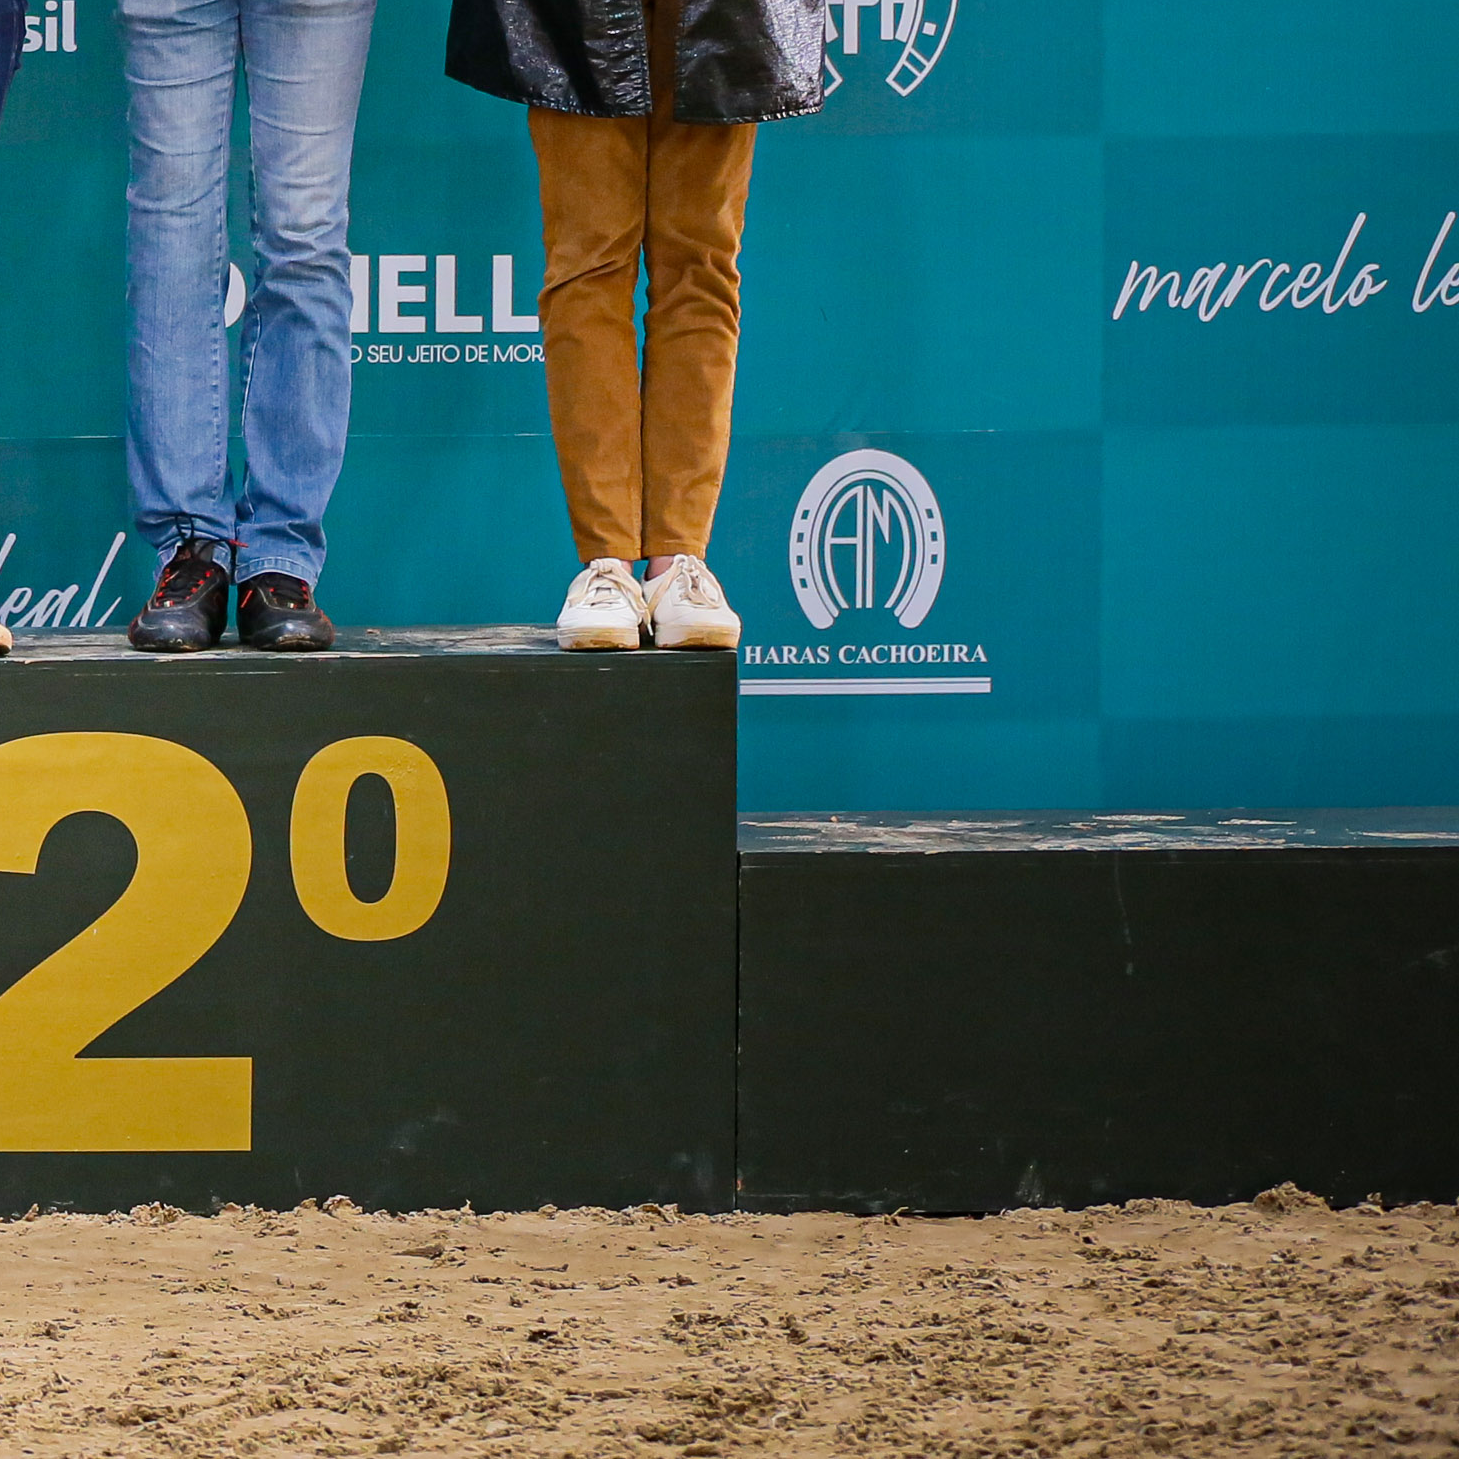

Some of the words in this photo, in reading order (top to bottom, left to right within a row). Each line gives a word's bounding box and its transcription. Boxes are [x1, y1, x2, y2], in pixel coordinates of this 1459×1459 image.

[1112, 212, 1388, 323] marcelo
[367, 344, 404, 364] SEU
[407, 344, 461, 364] JEITO
[465, 344, 489, 363] DE
[493, 344, 544, 363] MOR
[744, 645, 831, 665] HARAS
[838, 644, 988, 665] CACHOEIRA
